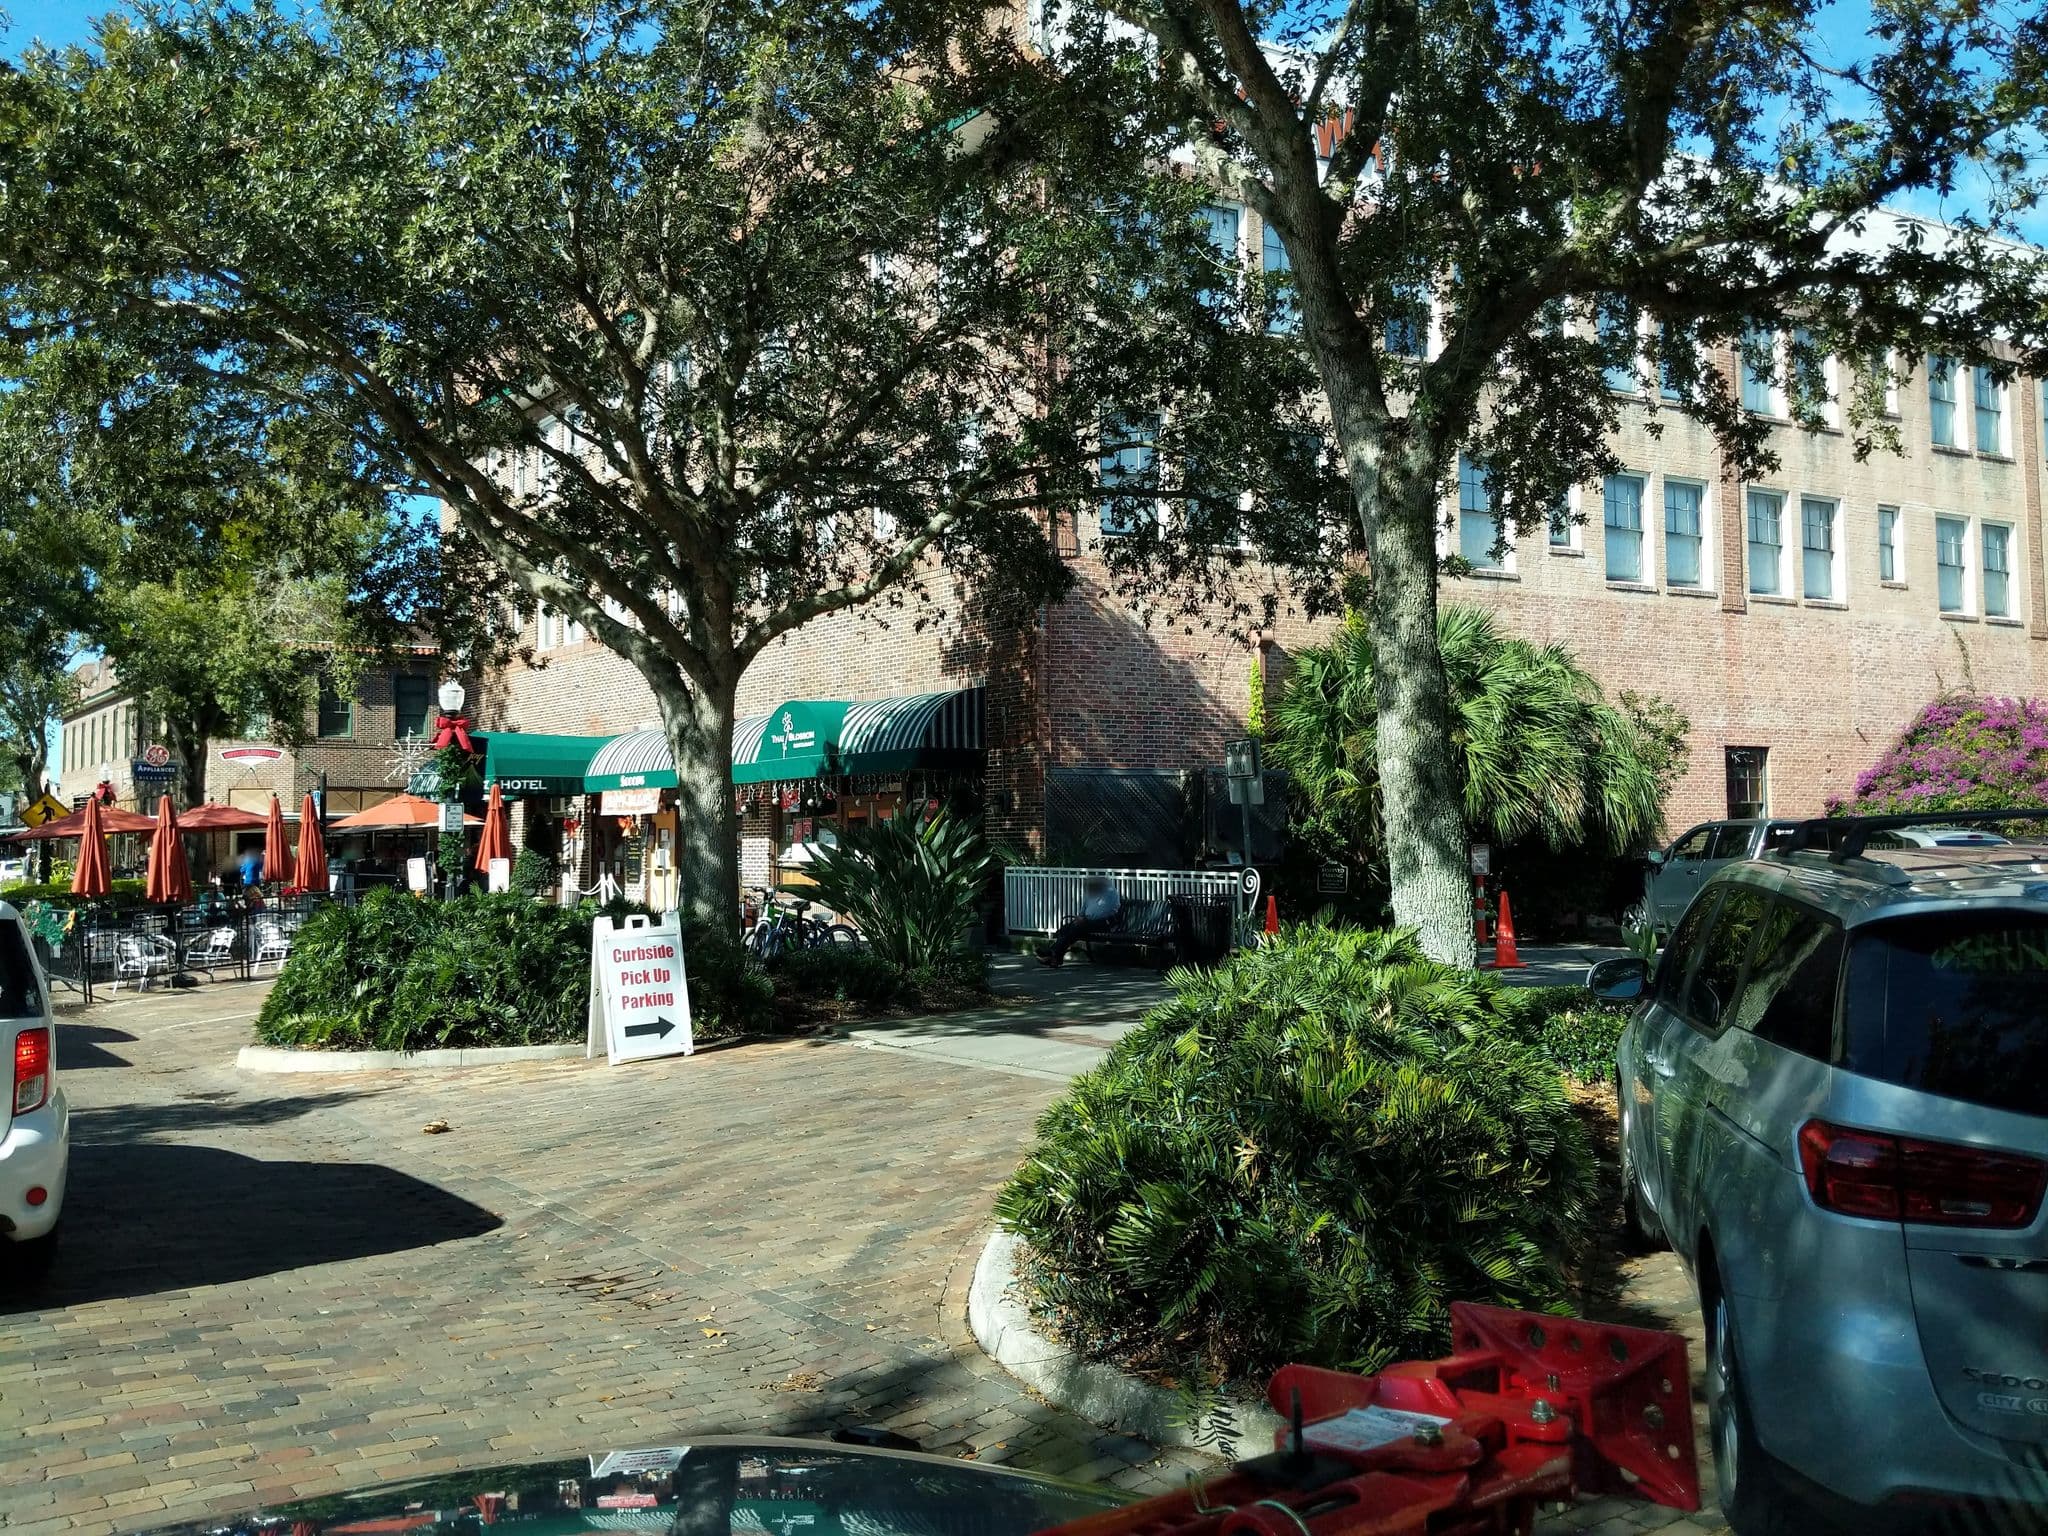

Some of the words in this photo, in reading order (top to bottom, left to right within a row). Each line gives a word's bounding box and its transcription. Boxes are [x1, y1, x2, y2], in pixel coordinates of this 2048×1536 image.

[137, 765, 176, 773] APPLIANCES
[500, 779, 547, 790] HOTEL
[613, 945, 674, 963] Curbside
[621, 970, 651, 986] Pick
[653, 967, 671, 983] Up
[621, 993, 674, 1010] Parking
